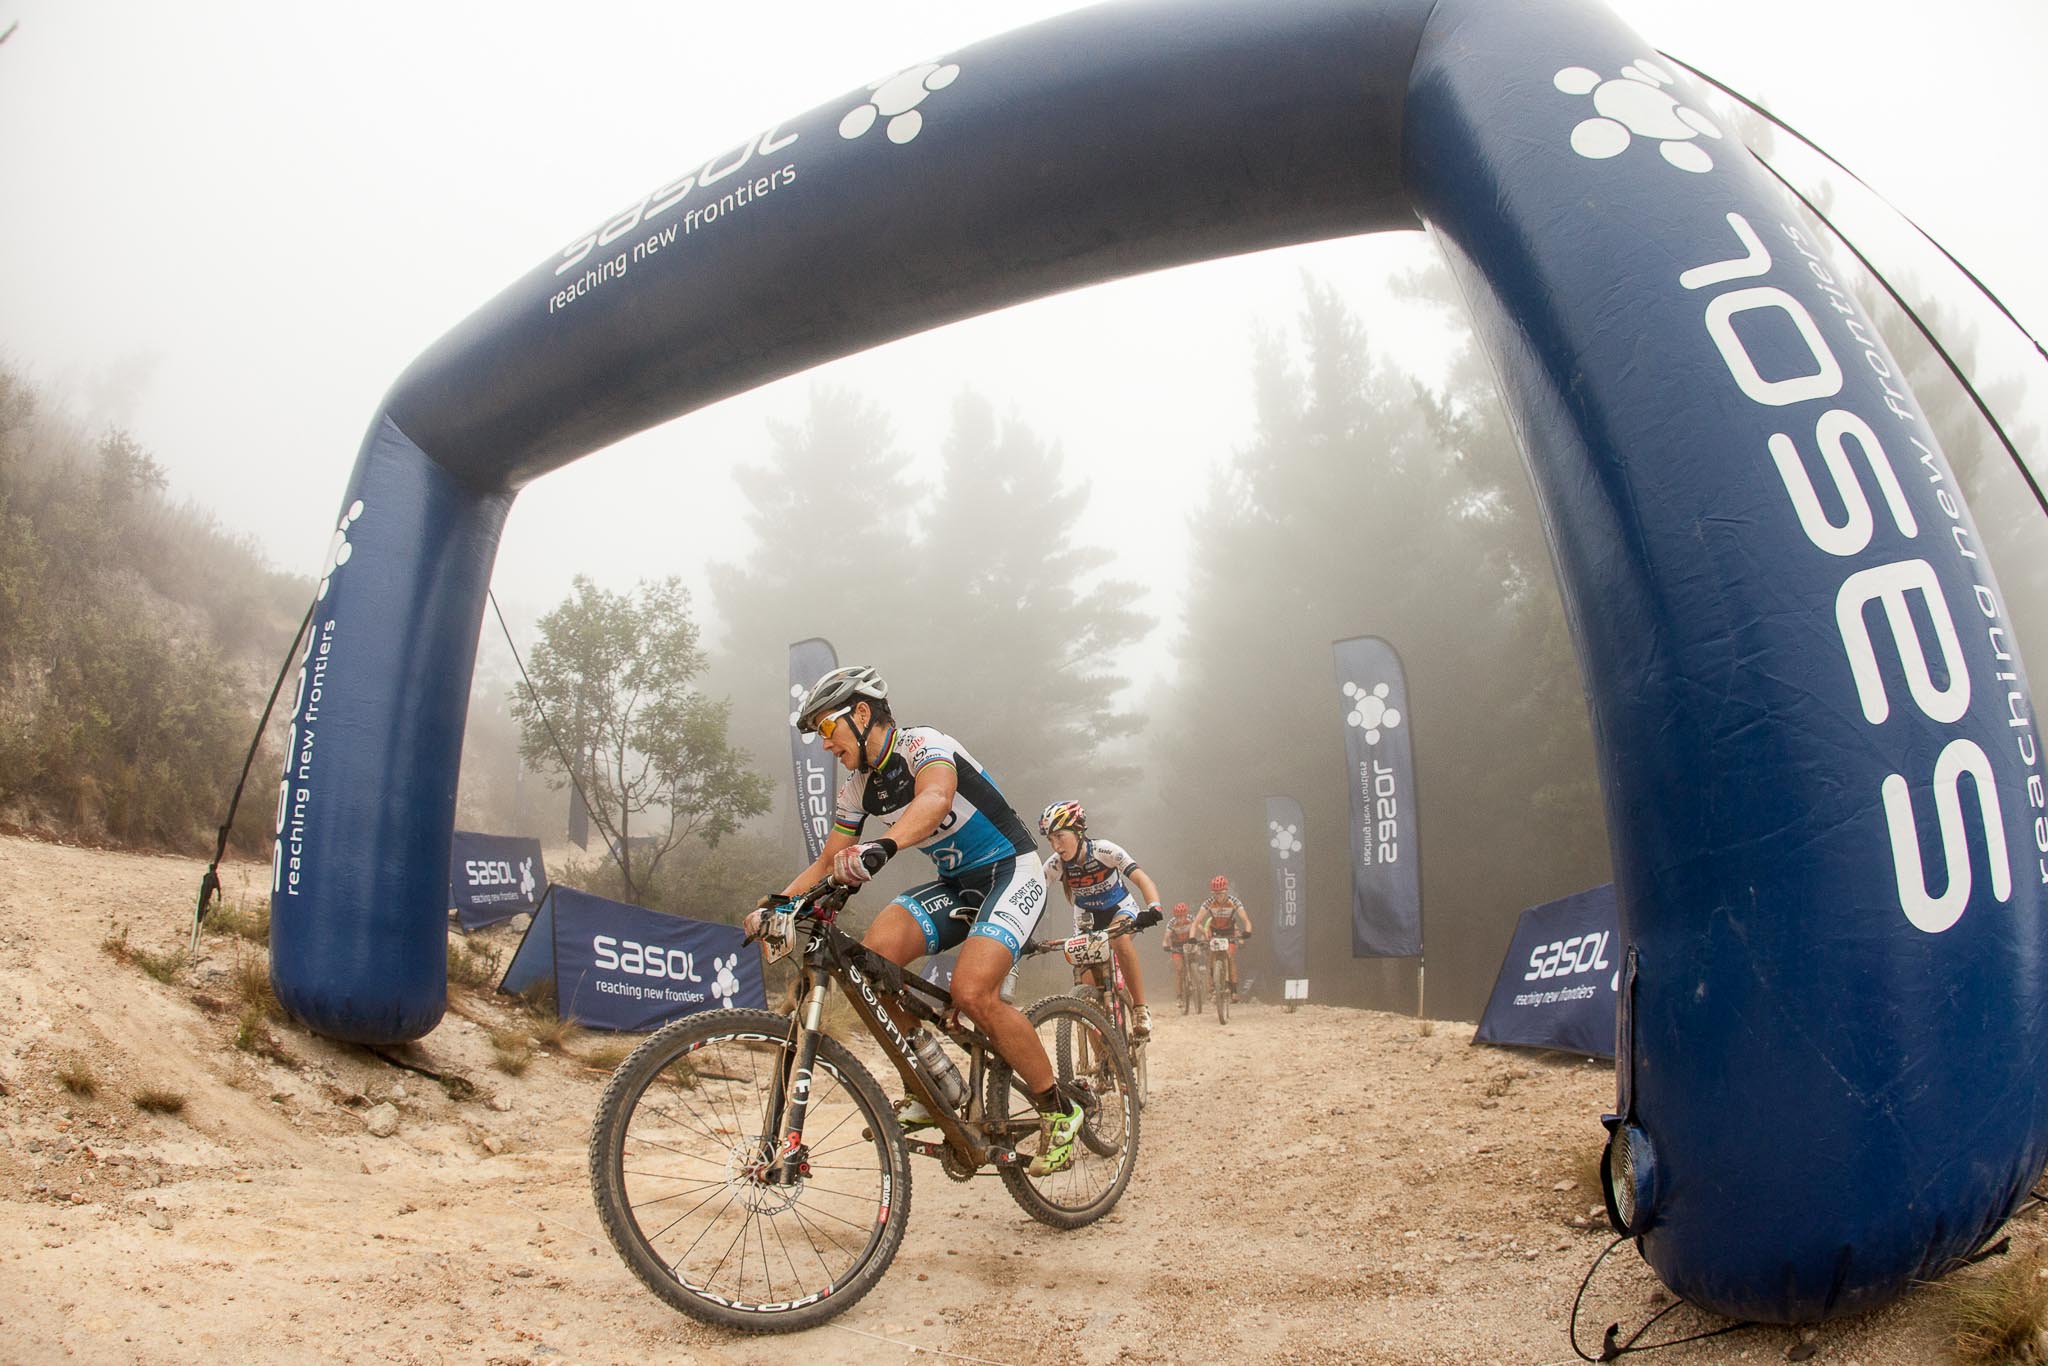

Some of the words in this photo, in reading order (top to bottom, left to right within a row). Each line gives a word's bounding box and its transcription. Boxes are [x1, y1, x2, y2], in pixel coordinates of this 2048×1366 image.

[549, 251, 627, 314] reaching
[633, 223, 678, 264] new
[684, 163, 797, 235] frontiers
[1781, 223, 1914, 421] frontiers
[1910, 436, 1976, 560] new
[305, 619, 336, 723] frontiers
[298, 730, 315, 780] new
[1973, 584, 2048, 885] reaching
[288, 787, 311, 896] reaching
[1008, 885, 1029, 906] SPORT
[1025, 877, 1037, 892] FOR
[1018, 883, 1043, 916] GOOD
[1067, 944, 1087, 954] CAPE
[1074, 950, 1102, 962] 54-2
[596, 979, 642, 1000] reaching
[644, 988, 664, 1000] new
[665, 989, 705, 1003] frontiers
[864, 1221, 900, 1280] ROCKET
